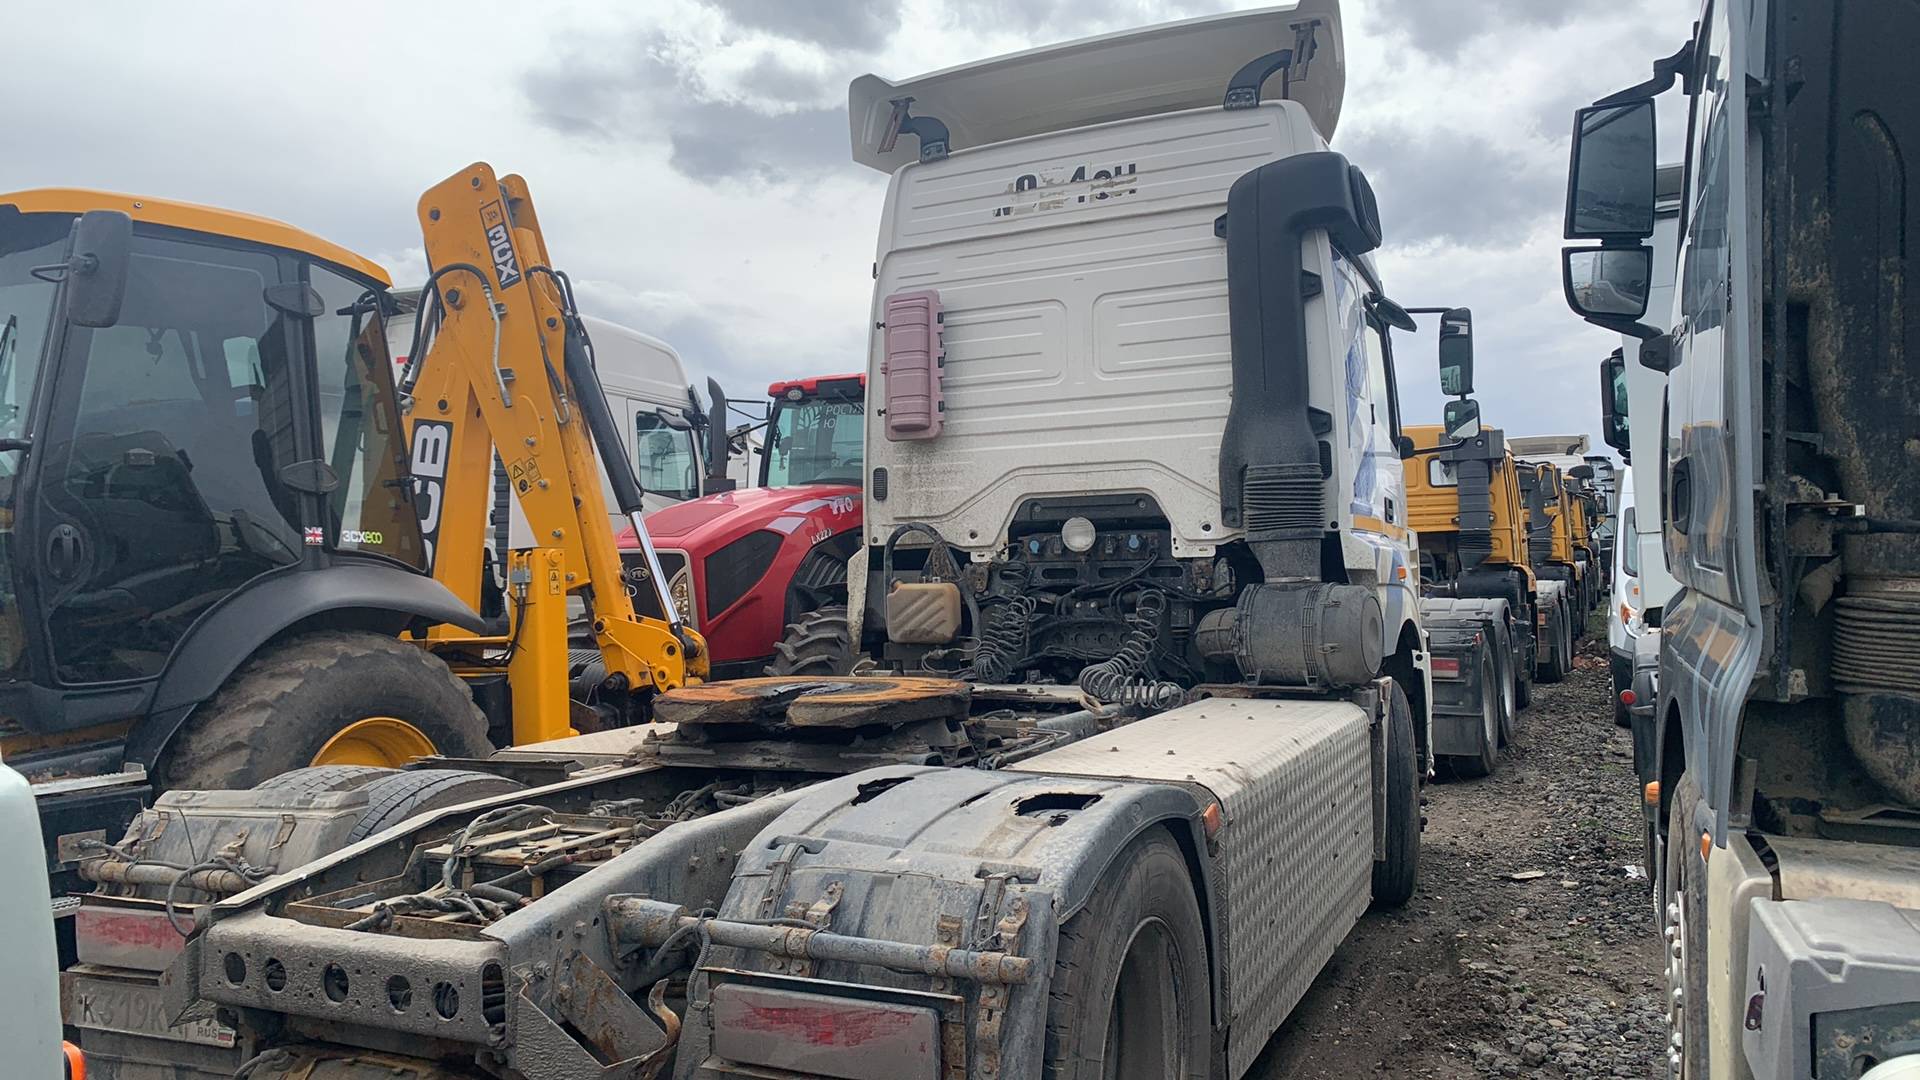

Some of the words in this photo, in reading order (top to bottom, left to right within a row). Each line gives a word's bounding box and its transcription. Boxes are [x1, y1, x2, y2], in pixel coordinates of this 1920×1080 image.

[487, 224, 519, 282] 3CX
[411, 424, 448, 569] CB
[342, 530, 383, 544] 3CXeco
[81, 993, 184, 1034] K319K
[196, 1026, 218, 1040] RUS
